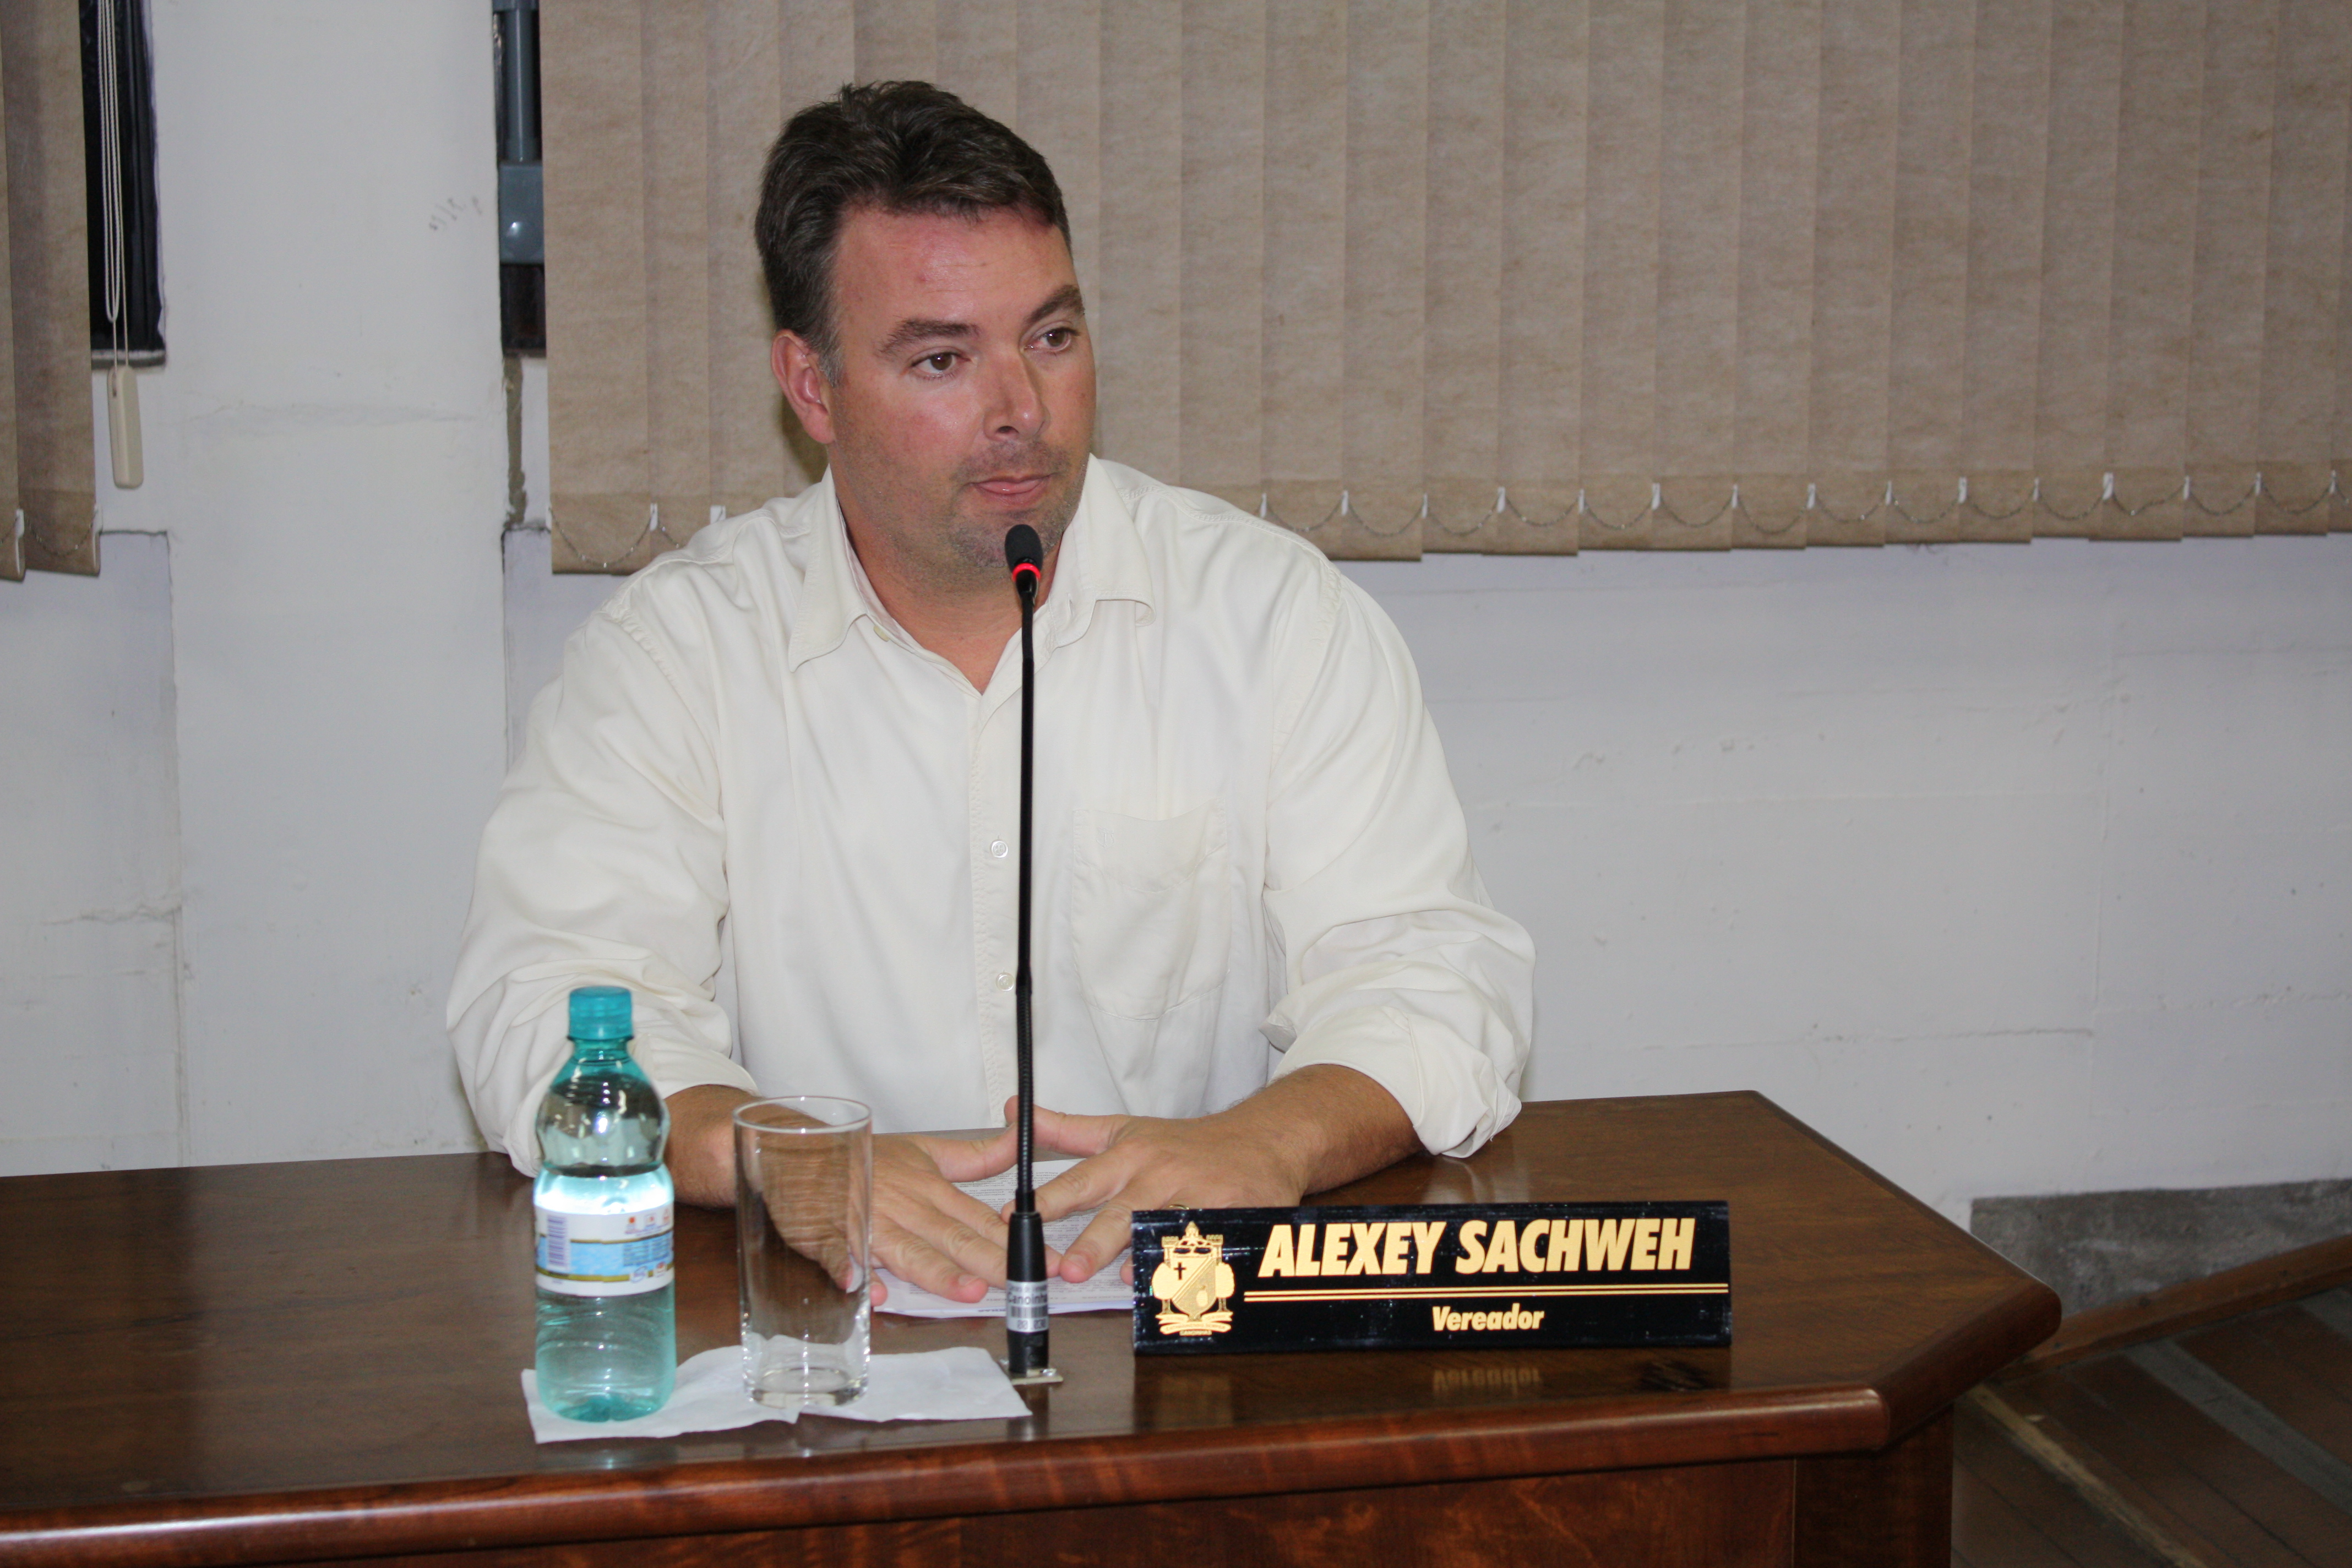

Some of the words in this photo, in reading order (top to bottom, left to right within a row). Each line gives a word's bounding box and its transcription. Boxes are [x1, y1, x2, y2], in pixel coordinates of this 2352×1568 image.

[1257, 1221, 1447, 1278] ALEXEY
[1455, 1218, 1696, 1275] SACHWEH
[1432, 1303, 1545, 1331] Vereador
